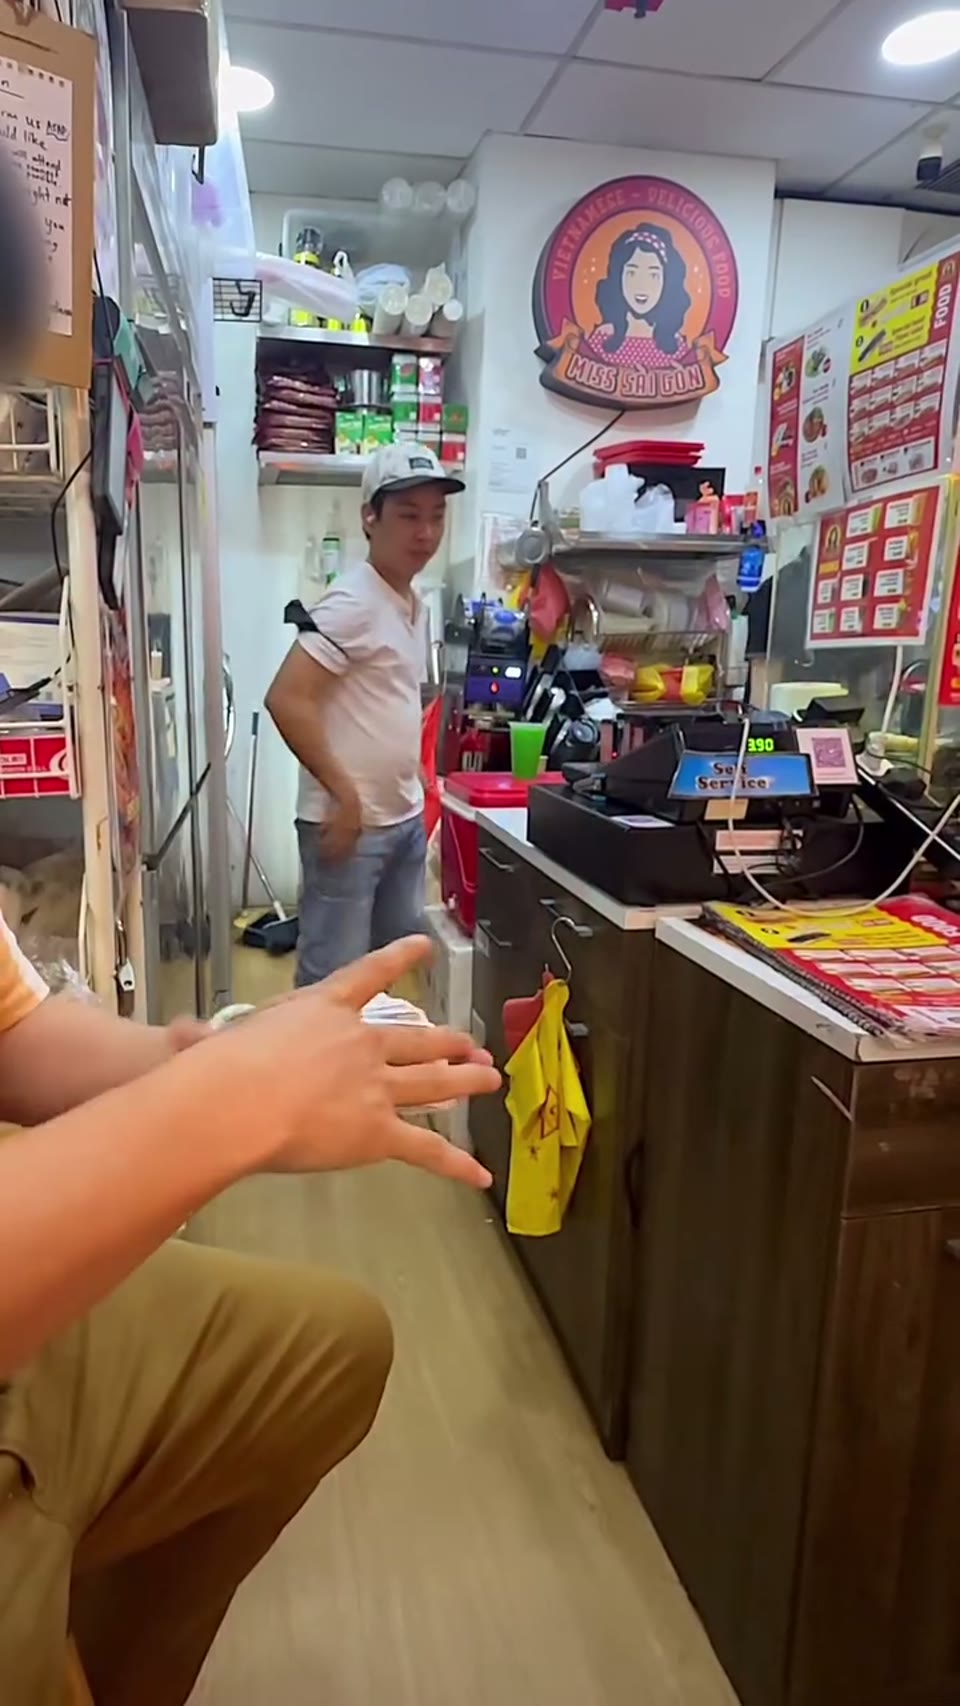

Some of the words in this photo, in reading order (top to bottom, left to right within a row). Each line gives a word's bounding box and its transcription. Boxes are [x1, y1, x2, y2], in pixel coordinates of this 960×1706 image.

[24, 130, 47, 151] like
[552, 188, 625, 280] VIETNAMESE
[648, 187, 720, 250] DELICIOUS
[711, 249, 732, 298] FOOD
[934, 283, 952, 330] FOOD
[567, 354, 617, 392] MISS
